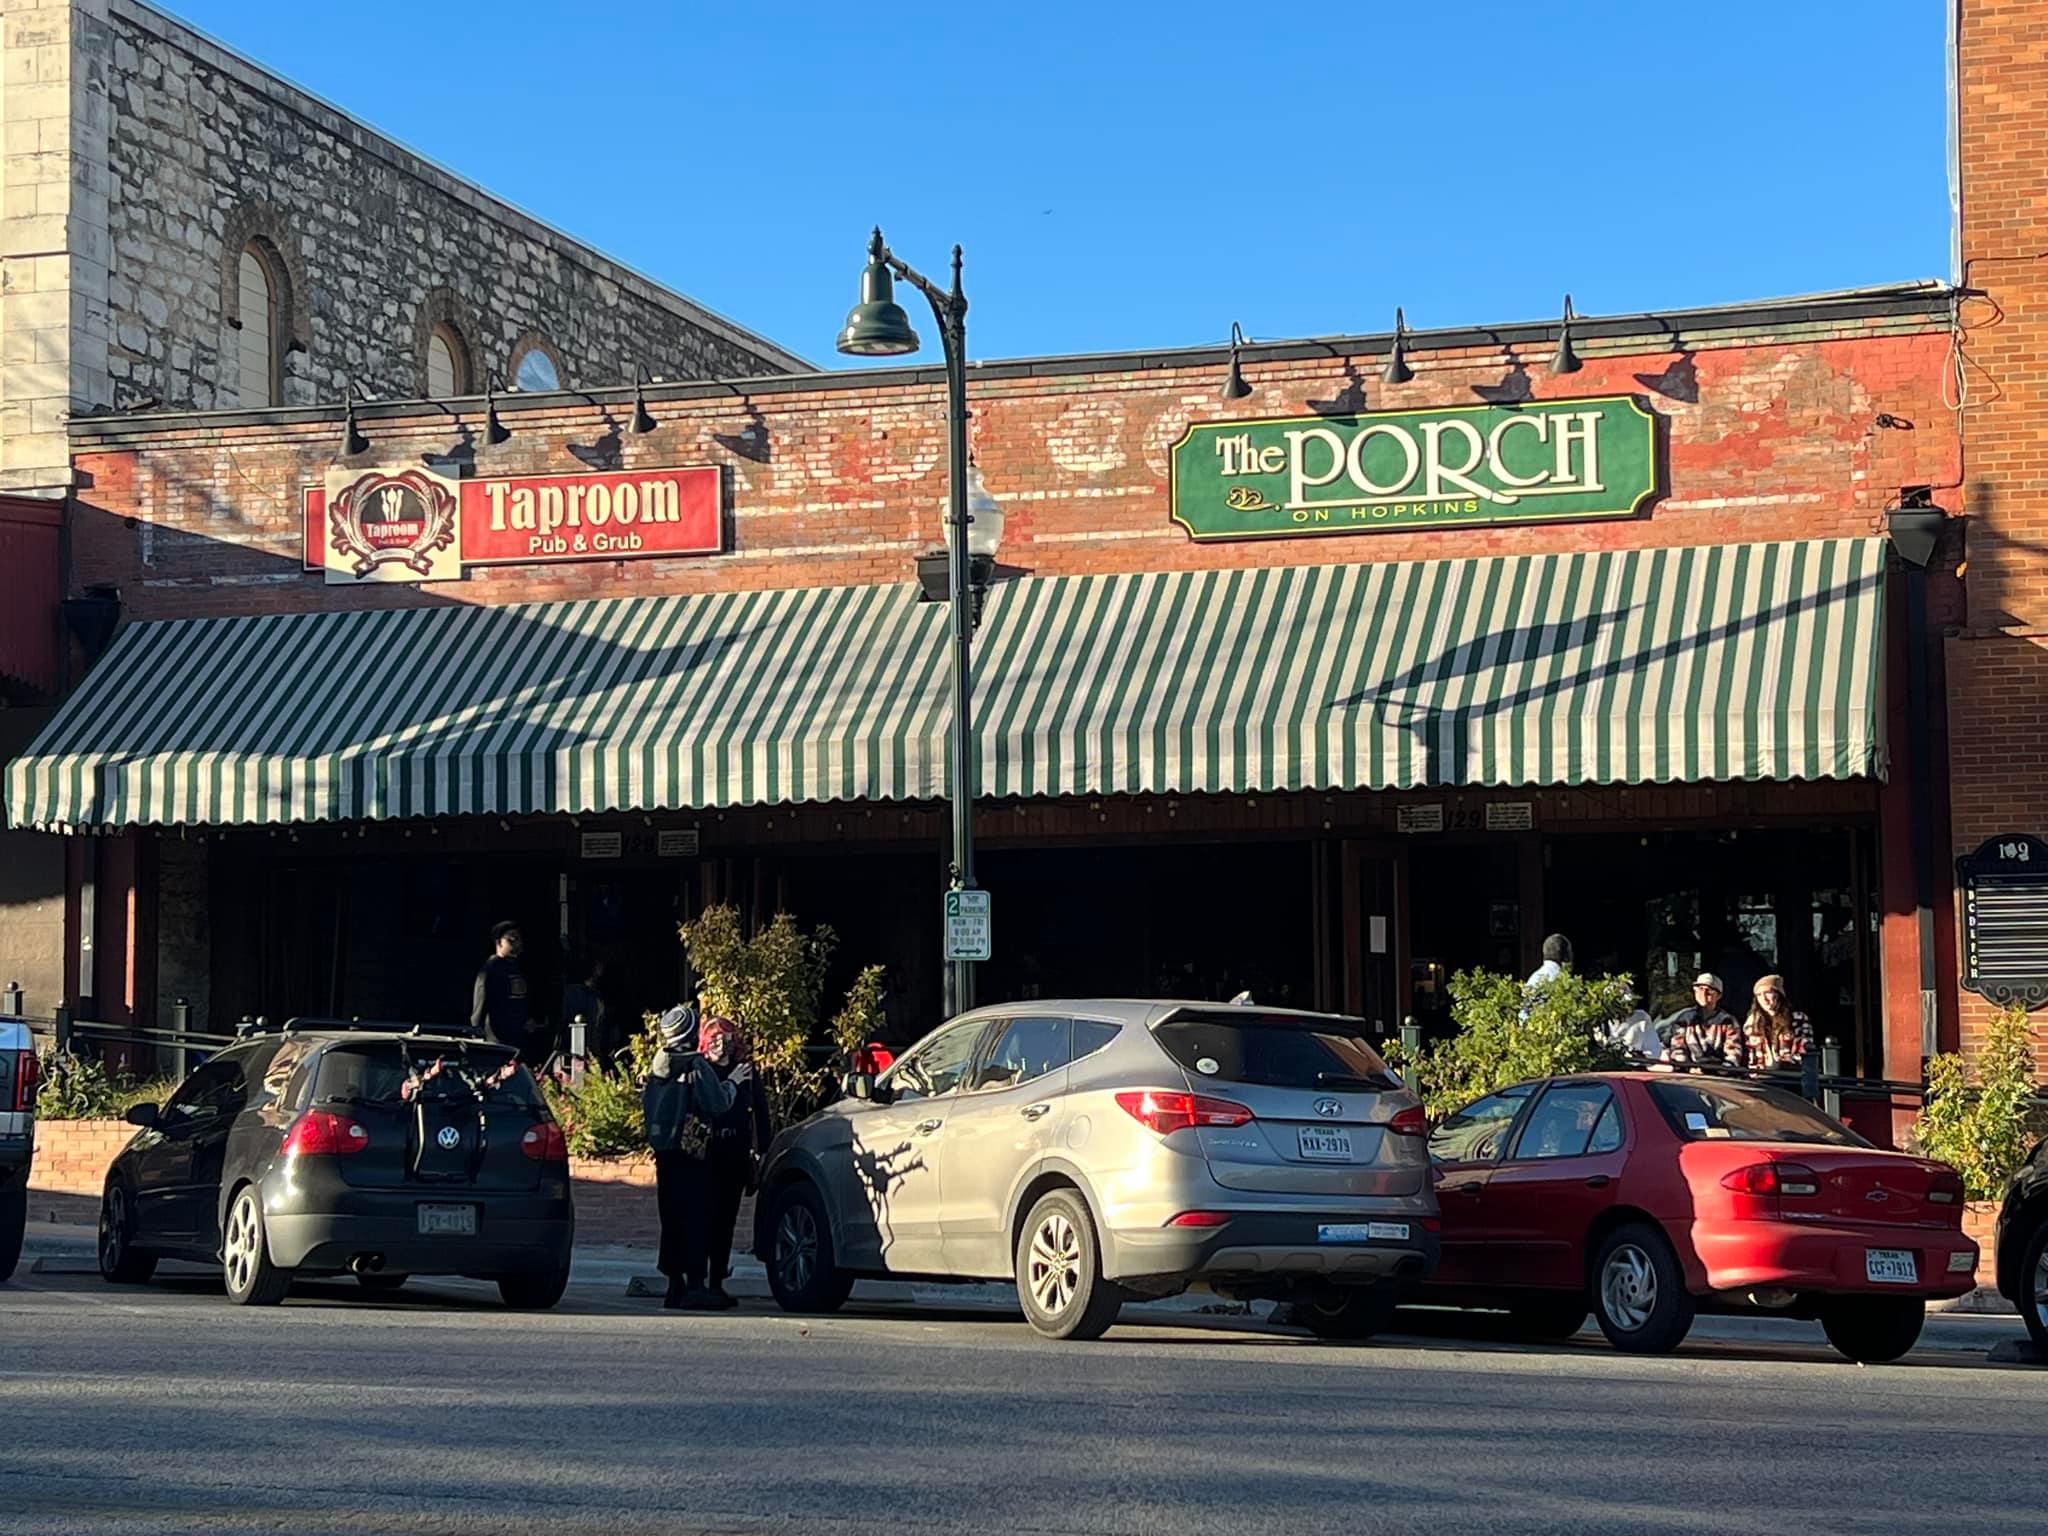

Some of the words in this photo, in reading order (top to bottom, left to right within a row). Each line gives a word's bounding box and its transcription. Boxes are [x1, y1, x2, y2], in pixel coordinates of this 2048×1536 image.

[1215, 433, 1286, 475] The
[1284, 411, 1604, 509] PORCH
[485, 478, 680, 535] Taproom
[1293, 509, 1330, 522] ON
[1351, 500, 1479, 520] HOPKINS
[366, 523, 419, 539] Taproom
[529, 535, 566, 554] Pub
[573, 534, 588, 552] &
[592, 533, 642, 551] Grub
[948, 896, 958, 914] 2
[1314, 1127, 1334, 1136] TEXAS
